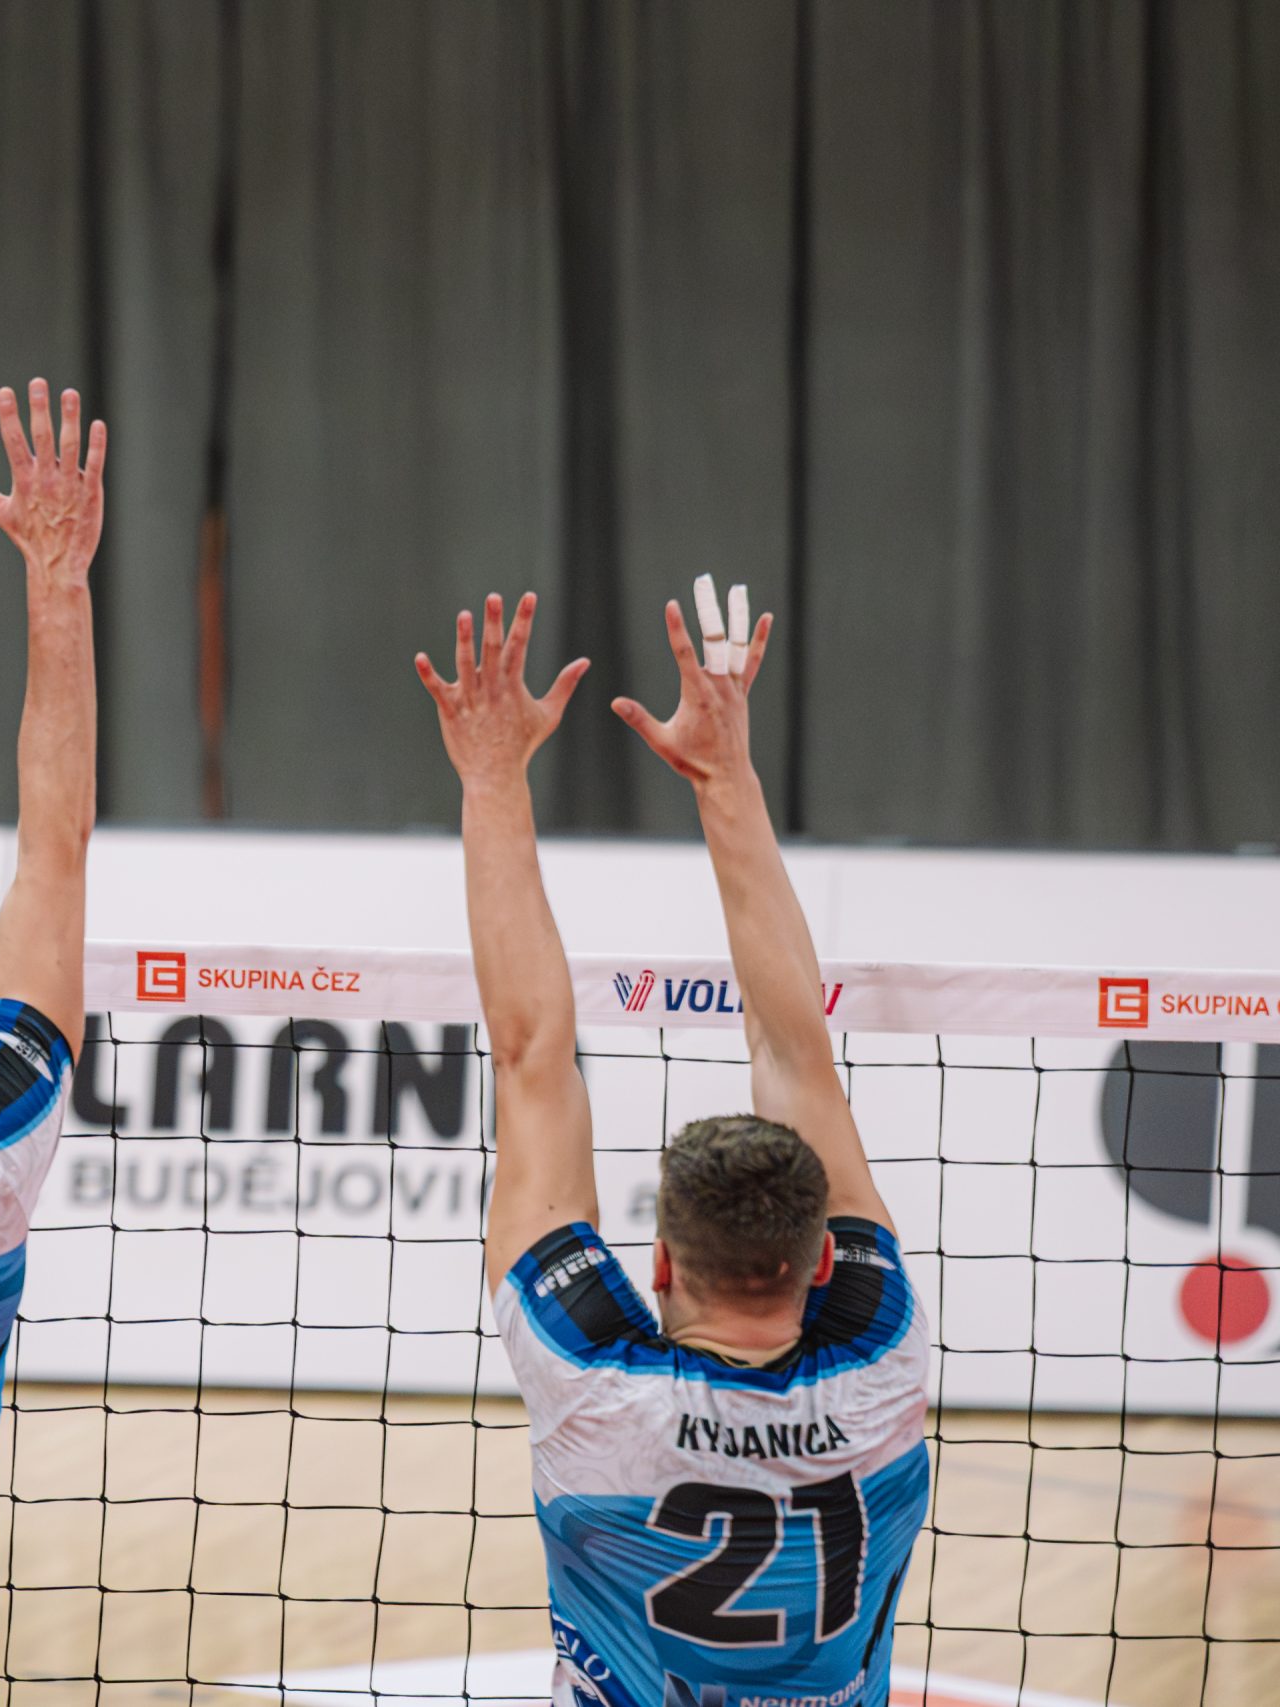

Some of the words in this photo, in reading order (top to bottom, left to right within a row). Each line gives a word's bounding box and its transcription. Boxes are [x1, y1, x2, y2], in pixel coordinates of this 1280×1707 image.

[198, 968, 304, 991] SKUPINA
[311, 966, 360, 993] ČEZ
[664, 979, 743, 1013] VOL
[1161, 994, 1269, 1016] SKUPINA
[72, 1014, 586, 1143] LARN
[69, 1149, 493, 1216] BUDĚJOVI
[677, 1413, 850, 1459] KYJANICA
[644, 1470, 869, 1648] 21
